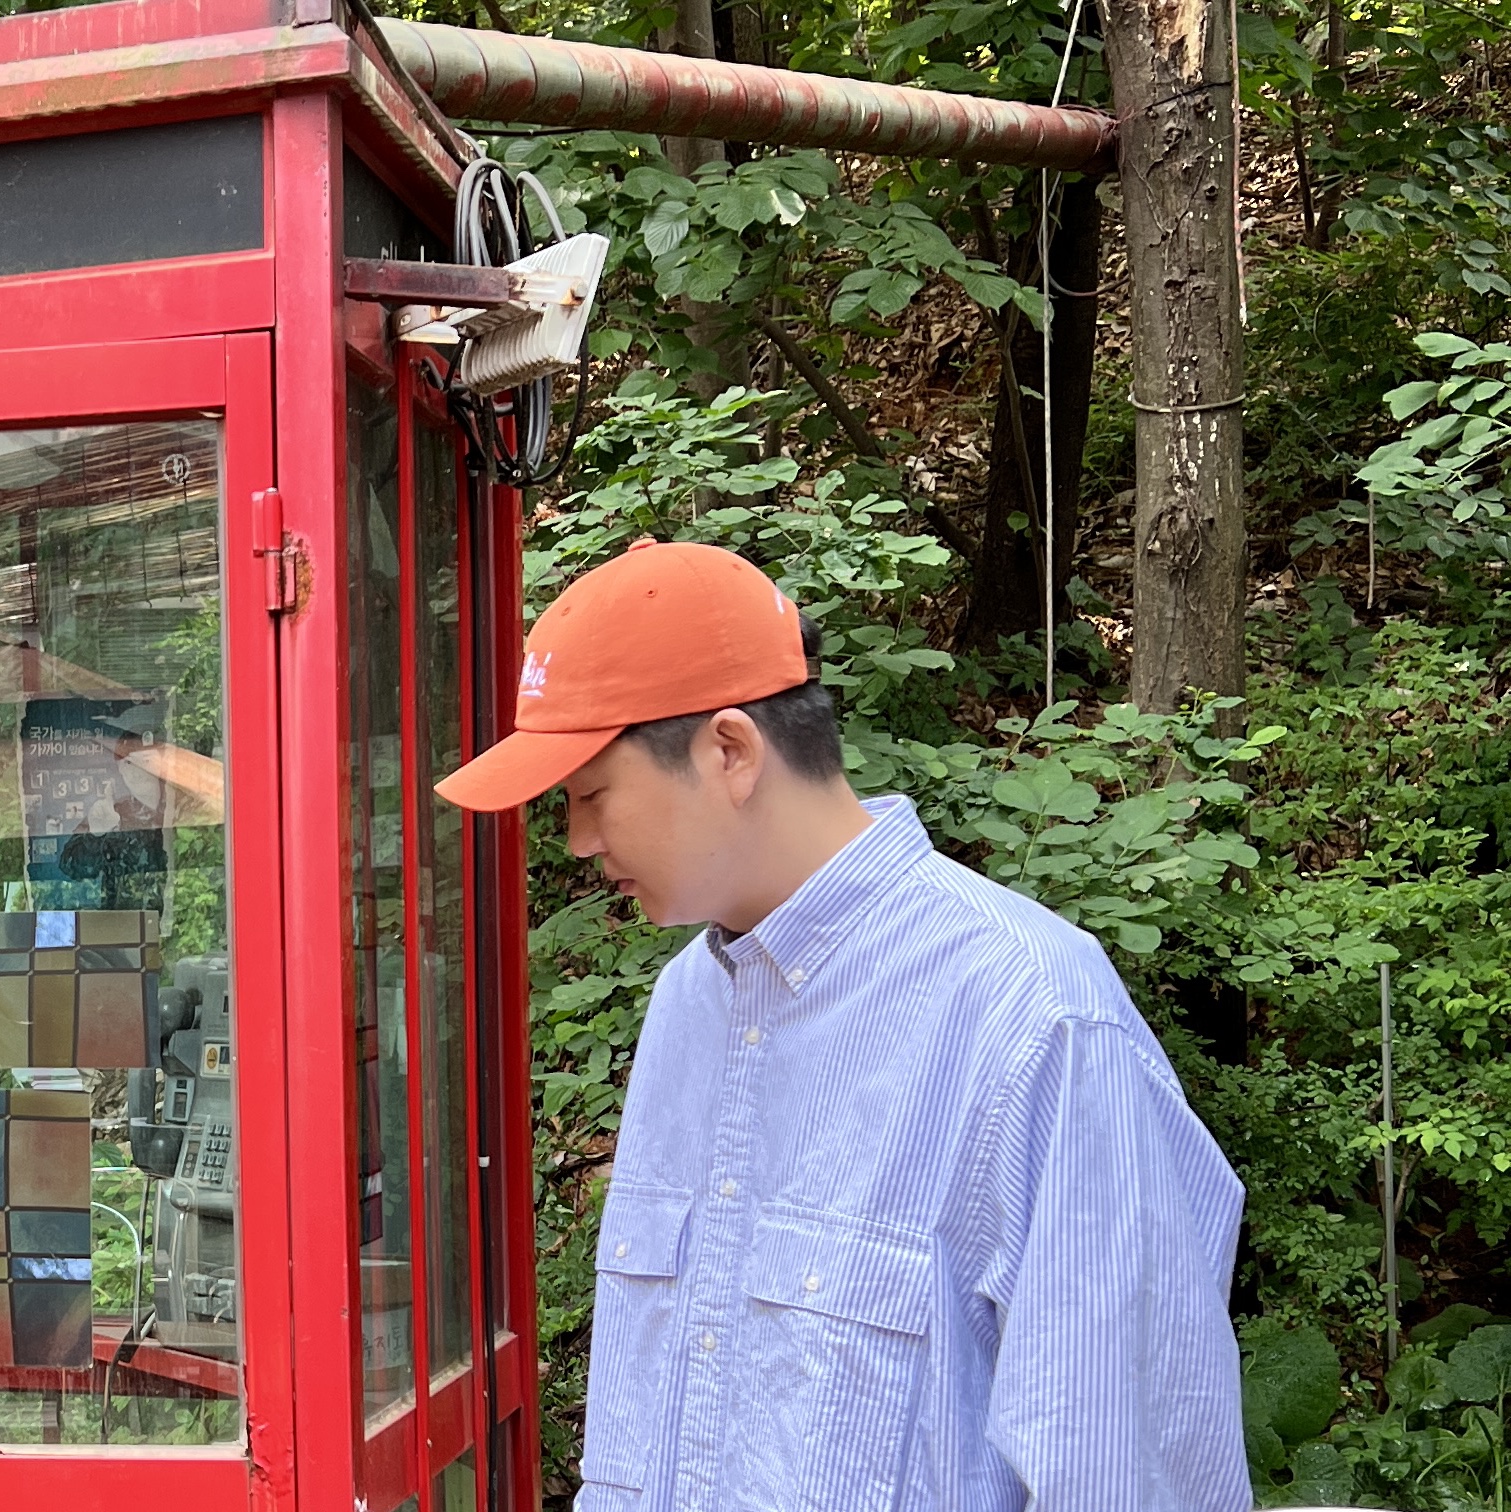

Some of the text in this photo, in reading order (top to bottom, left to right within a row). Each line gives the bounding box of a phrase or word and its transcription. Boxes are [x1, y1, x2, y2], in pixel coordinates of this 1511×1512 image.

[30, 725, 63, 741] 국가를
[66, 727, 93, 740] 지키는
[29, 741, 104, 757] 가까이 있습니다
